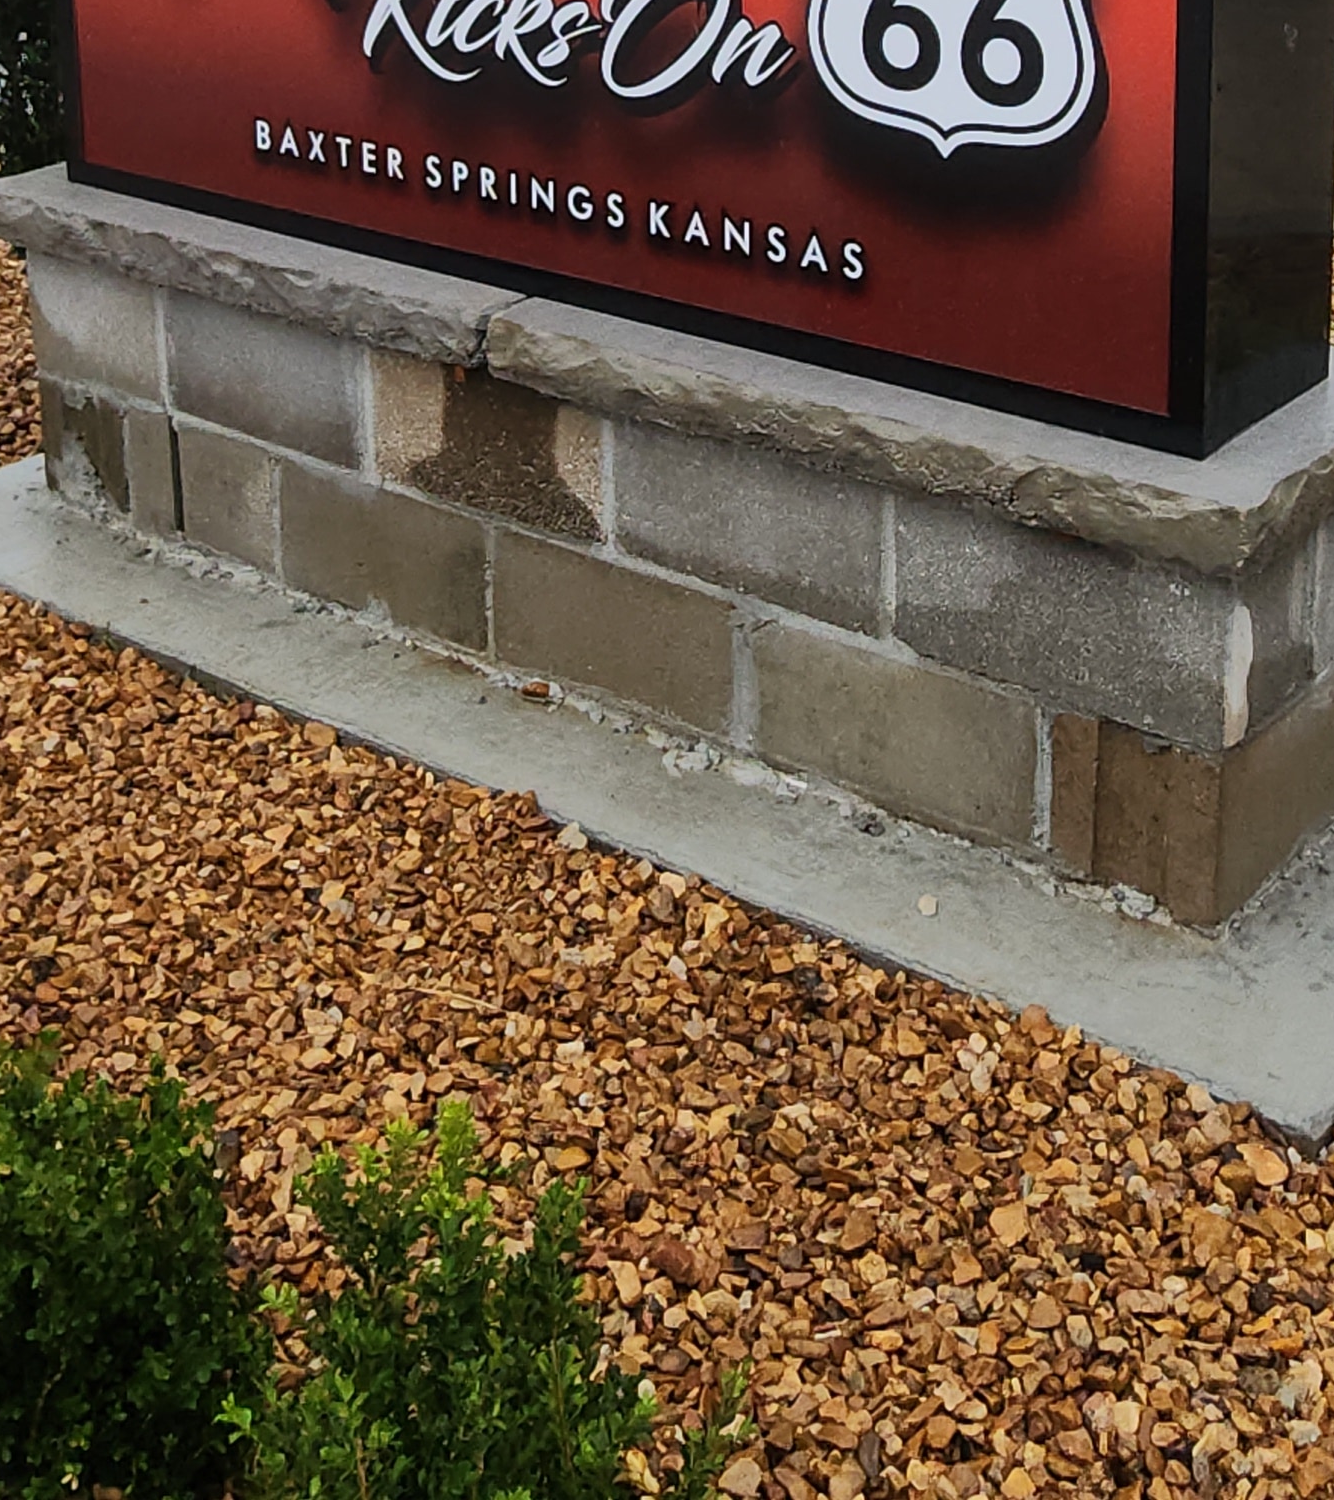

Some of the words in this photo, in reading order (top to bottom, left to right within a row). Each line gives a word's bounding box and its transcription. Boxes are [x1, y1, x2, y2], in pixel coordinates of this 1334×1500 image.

[254, 118, 404, 181] BAXTER
[424, 154, 625, 229] SPRINGS
[649, 203, 866, 281] KANSAS
